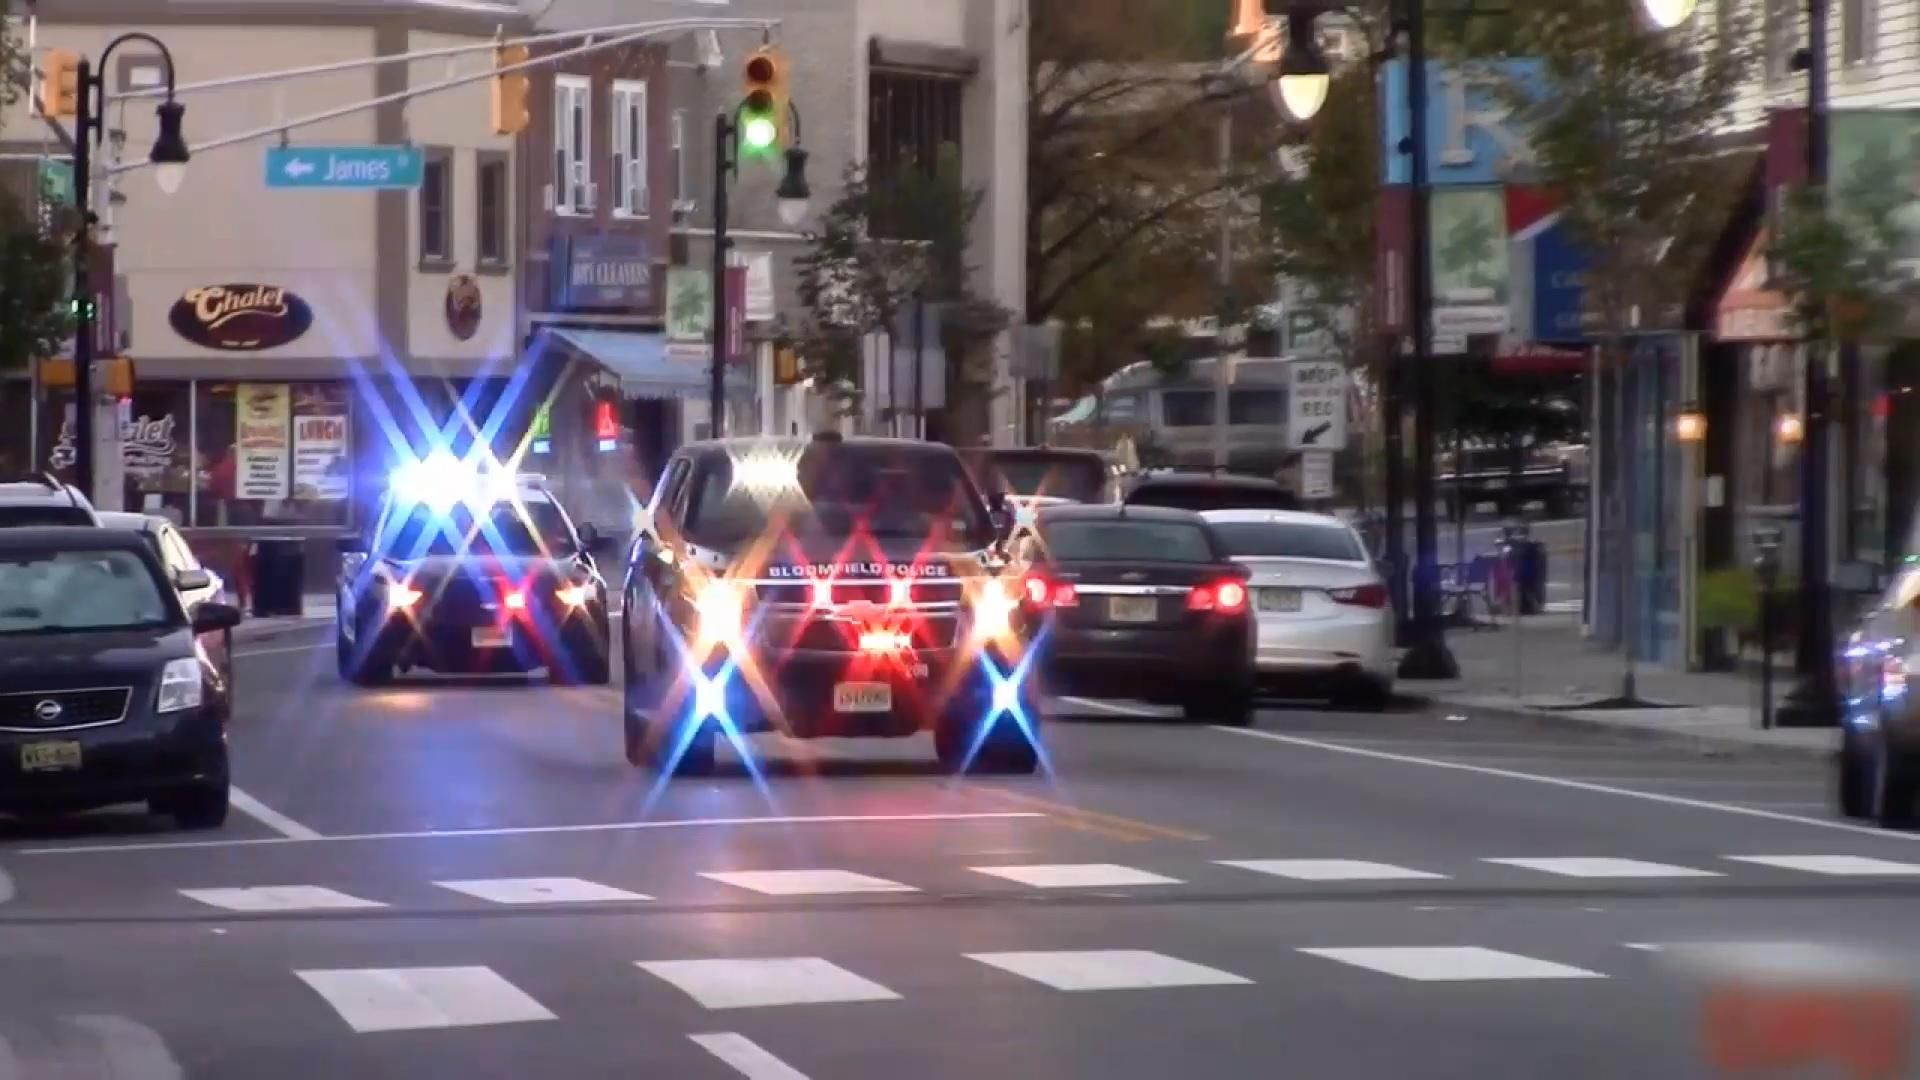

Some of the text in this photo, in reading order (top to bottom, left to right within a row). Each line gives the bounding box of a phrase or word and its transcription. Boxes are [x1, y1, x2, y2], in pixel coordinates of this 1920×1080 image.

[323, 154, 390, 180] James
[184, 283, 286, 322] Chalet
[768, 562, 947, 577] BLOOMFIELD POLICE
